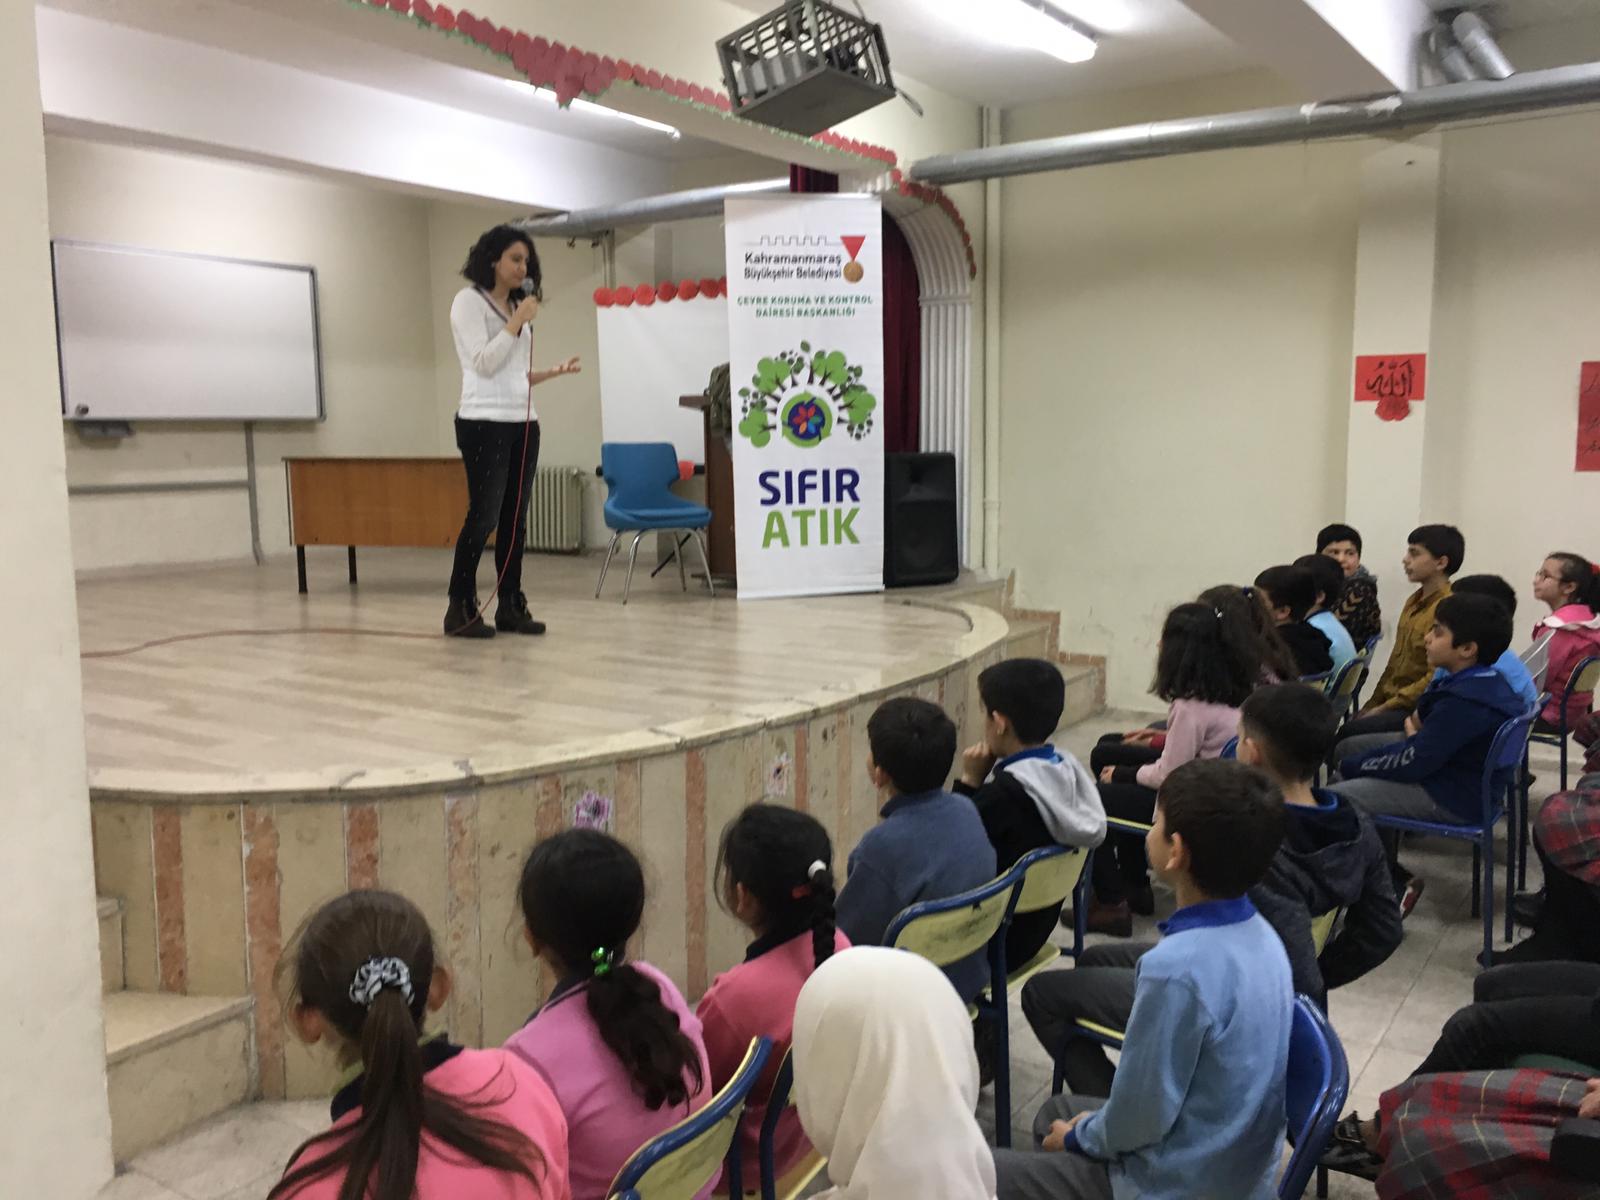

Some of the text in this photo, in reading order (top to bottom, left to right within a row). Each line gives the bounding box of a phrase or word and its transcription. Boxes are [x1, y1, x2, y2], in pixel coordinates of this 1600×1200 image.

[744, 252, 842, 266] Kahramanmaraş
[744, 266, 842, 282] Büyükşehir Belediyesi
[737, 295, 873, 306] ÇEVRE KORUMA VE KONTROL
[755, 307, 856, 318] DAİRESİ BAŞKANLIĞI
[758, 468, 861, 506] SIFIR
[762, 508, 861, 549] ATIK
